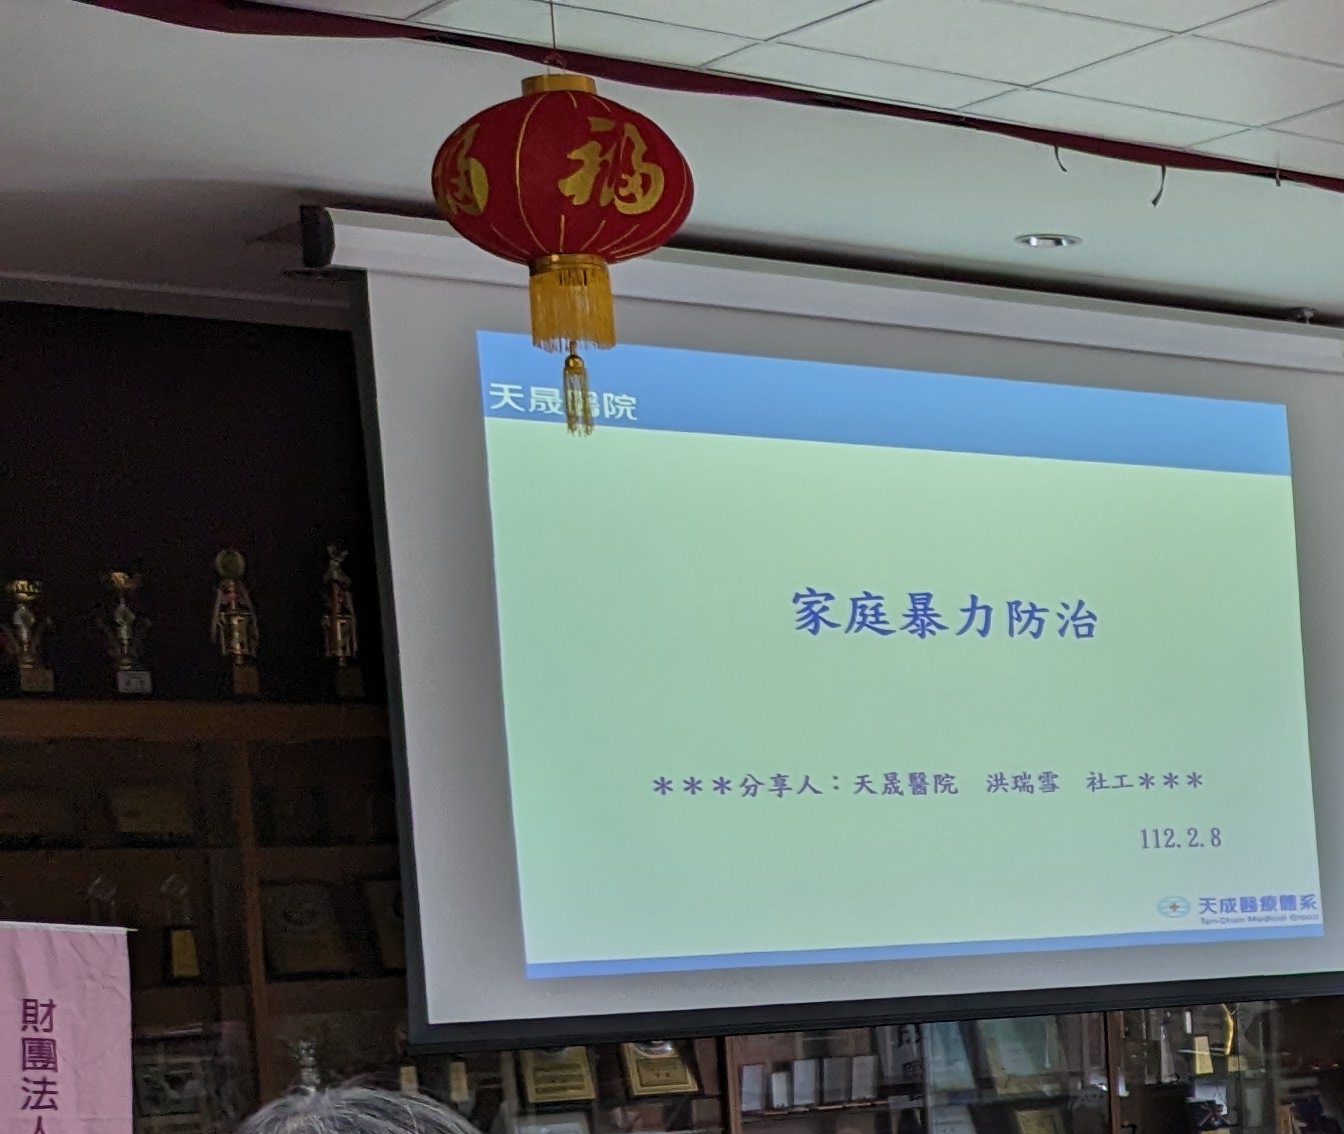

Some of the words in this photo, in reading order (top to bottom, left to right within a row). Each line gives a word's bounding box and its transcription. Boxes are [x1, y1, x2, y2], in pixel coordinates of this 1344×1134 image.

[558, 116, 665, 215] 福
[792, 586, 1098, 640] 家庭暴力防治
[986, 771, 1060, 794] 洪瑞雪
[1140, 827, 1222, 849] 112.2.8
